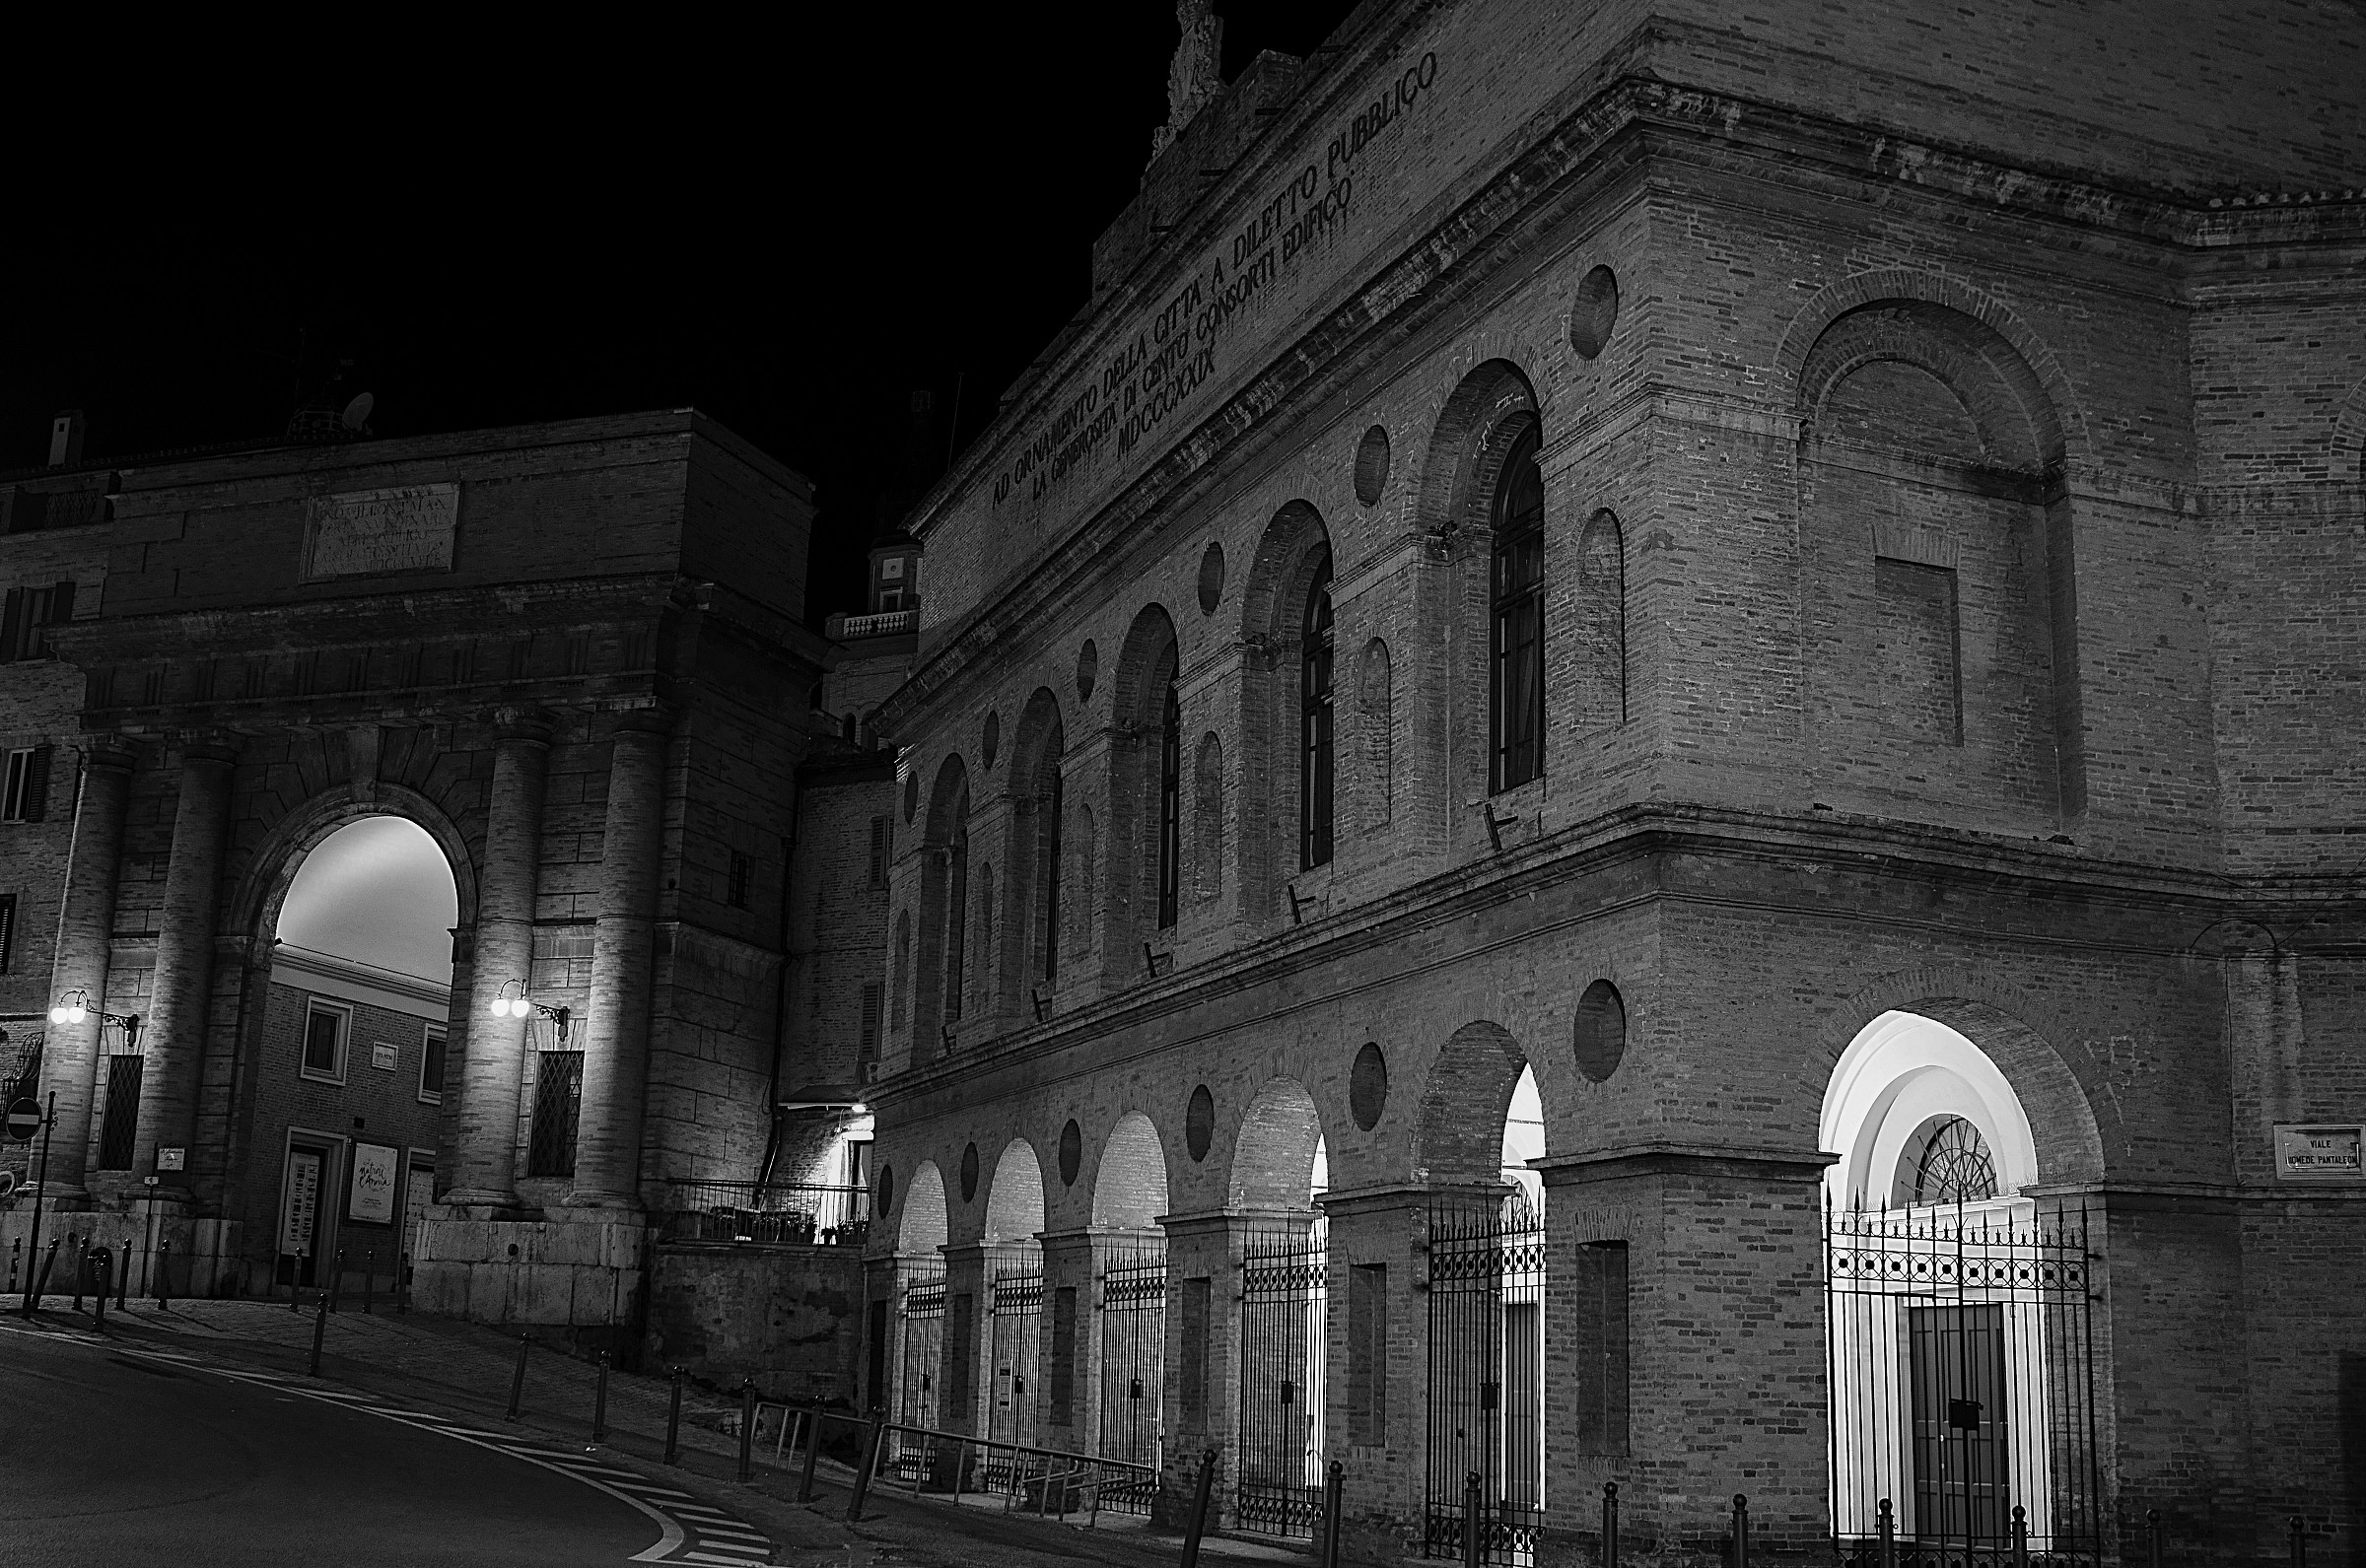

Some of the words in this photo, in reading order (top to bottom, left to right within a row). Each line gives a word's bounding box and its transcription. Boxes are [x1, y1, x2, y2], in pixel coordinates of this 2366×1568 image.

[992, 473, 1009, 510] AD
[1014, 385, 1097, 484] ORNAMENTO
[1103, 334, 1148, 399] DELLA
[1212, 256, 1224, 293] A
[1233, 166, 1317, 270] DILETTO
[1327, 51, 1437, 179] PUBBLICO
[1033, 470, 1046, 501] LA
[1124, 379, 1137, 416] DI
[1143, 332, 1189, 392] CENTO
[1196, 246, 1275, 340] CONSORTI
